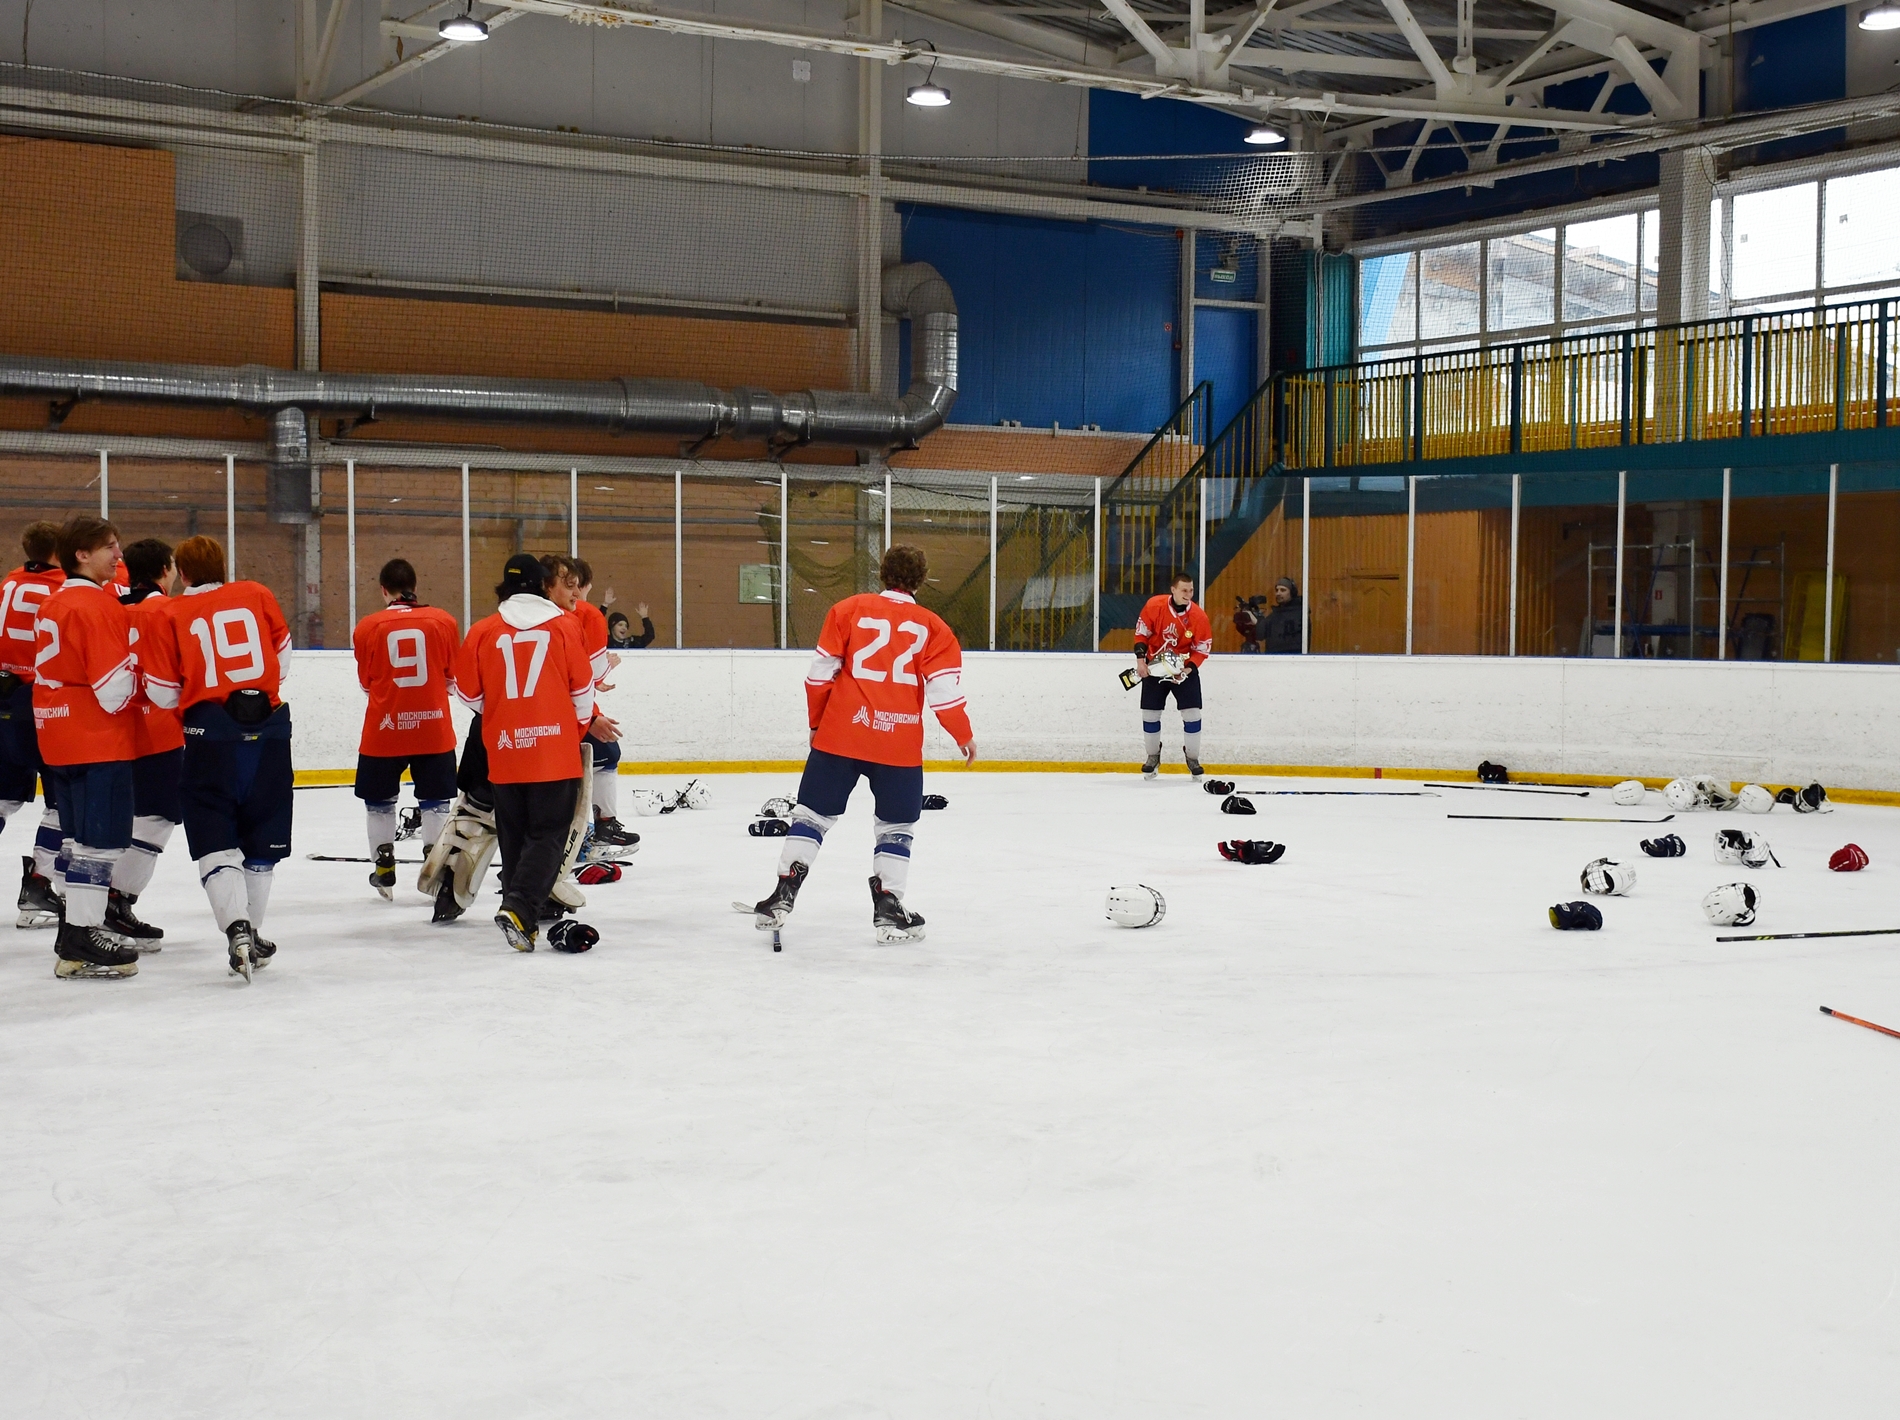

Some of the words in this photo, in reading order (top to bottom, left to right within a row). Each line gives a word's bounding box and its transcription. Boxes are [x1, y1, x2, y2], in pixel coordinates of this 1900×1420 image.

[0, 581, 51, 641] 15
[190, 608, 265, 688] 19
[852, 617, 928, 686] 22
[387, 628, 428, 688] 9
[496, 630, 550, 699] 17
[397, 708, 443, 721] МОСКОВСКИЙ
[874, 710, 919, 724] МОСКОВСКИЙ
[183, 726, 205, 736] AUER
[397, 720, 420, 730] СПОРТ
[514, 723, 561, 738] МОСКОВСКИЙ
[873, 720, 895, 732] СПОРТ
[515, 737, 537, 749] СПОРТ
